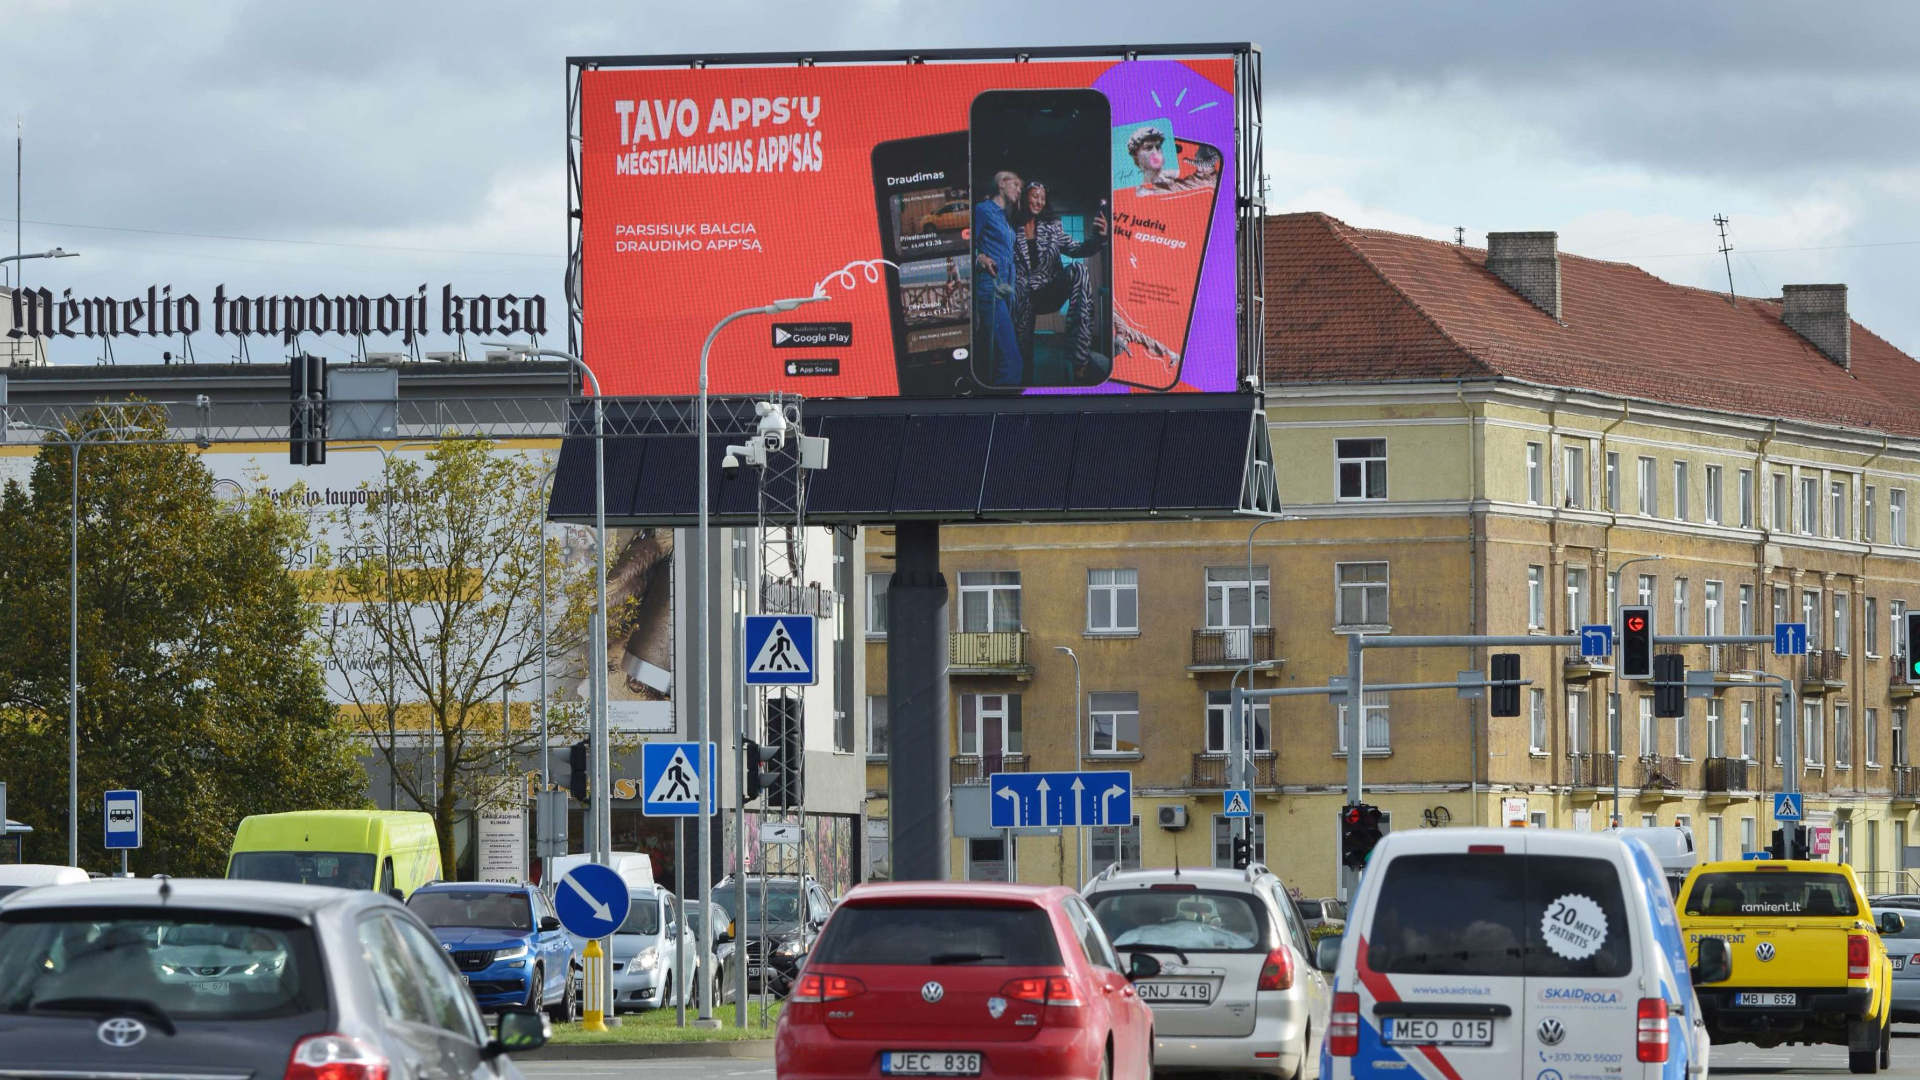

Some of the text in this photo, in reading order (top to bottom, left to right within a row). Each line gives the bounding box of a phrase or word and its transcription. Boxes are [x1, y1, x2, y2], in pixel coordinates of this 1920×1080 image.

[615, 98, 699, 145] TAVO
[616, 139, 753, 175] MĖGSTAMIAUSIAS
[887, 171, 945, 186] Draudimas
[700, 223, 757, 235] BALCIA
[1130, 215, 1167, 233] judrių
[615, 240, 702, 252] DRAUDIMO
[1134, 231, 1186, 249] apsauga
[213, 282, 428, 347] taupomoji
[443, 282, 548, 337] kasa
[793, 333, 850, 343] Google Play
[1551, 902, 1577, 926] 20
[1741, 901, 1801, 912] ramirent.lt
[1548, 923, 1589, 949] PATIRTIS
[1138, 985, 1207, 998] GNJ 419
[1412, 986, 1491, 995] www.skaidrola.lt
[1544, 988, 1617, 1004] SKAIDROLA
[1743, 994, 1765, 1004] MBI
[1774, 994, 1794, 1004] 652
[1396, 1021, 1438, 1039] MEO
[1452, 1021, 1487, 1039] 015
[893, 1054, 931, 1070] JEC
[944, 1055, 977, 1070] 836
[1549, 1053, 1622, 1062] +370 700 55007
